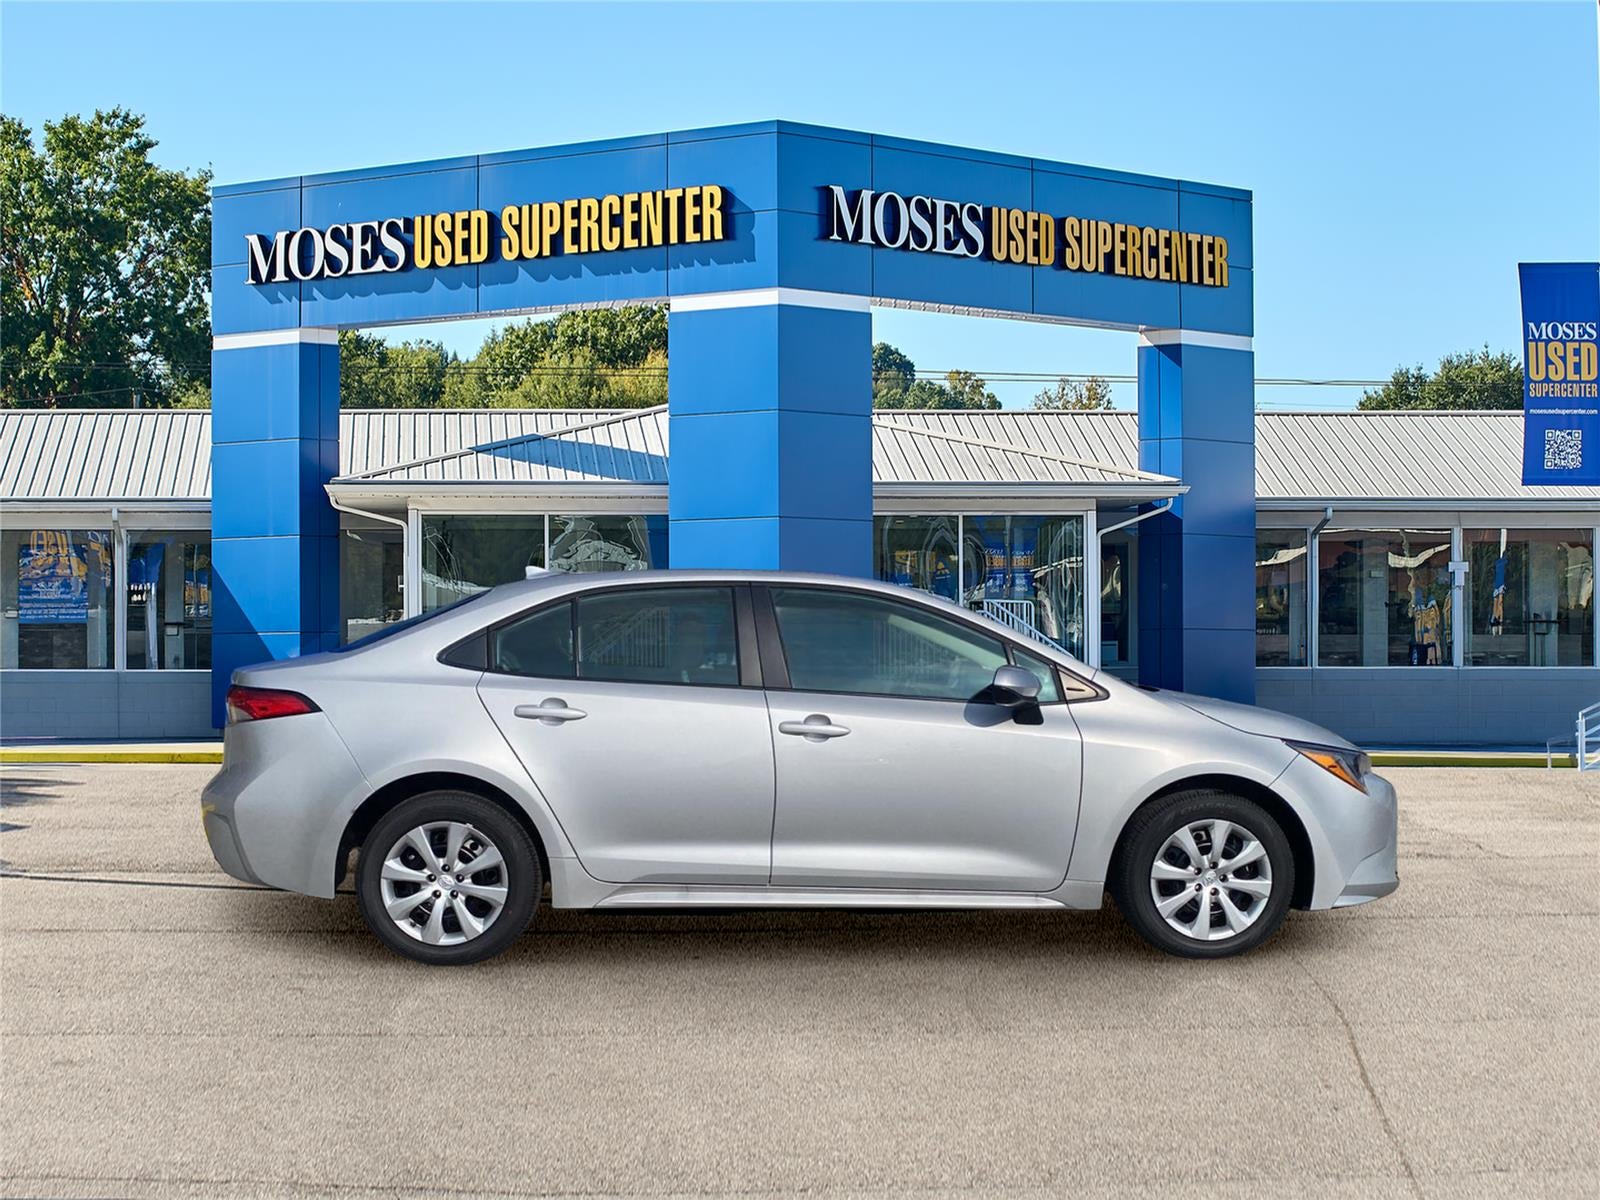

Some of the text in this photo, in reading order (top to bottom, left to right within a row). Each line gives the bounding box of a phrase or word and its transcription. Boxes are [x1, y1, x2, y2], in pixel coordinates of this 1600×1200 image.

[244, 184, 724, 285] MOSES USED SUPERCENTER
[828, 184, 1229, 287] MOSES USED SUPERCENTER
[1527, 321, 1597, 340] MOSES
[1528, 341, 1598, 381] USED
[1529, 383, 1598, 398] SUPERCENTER
